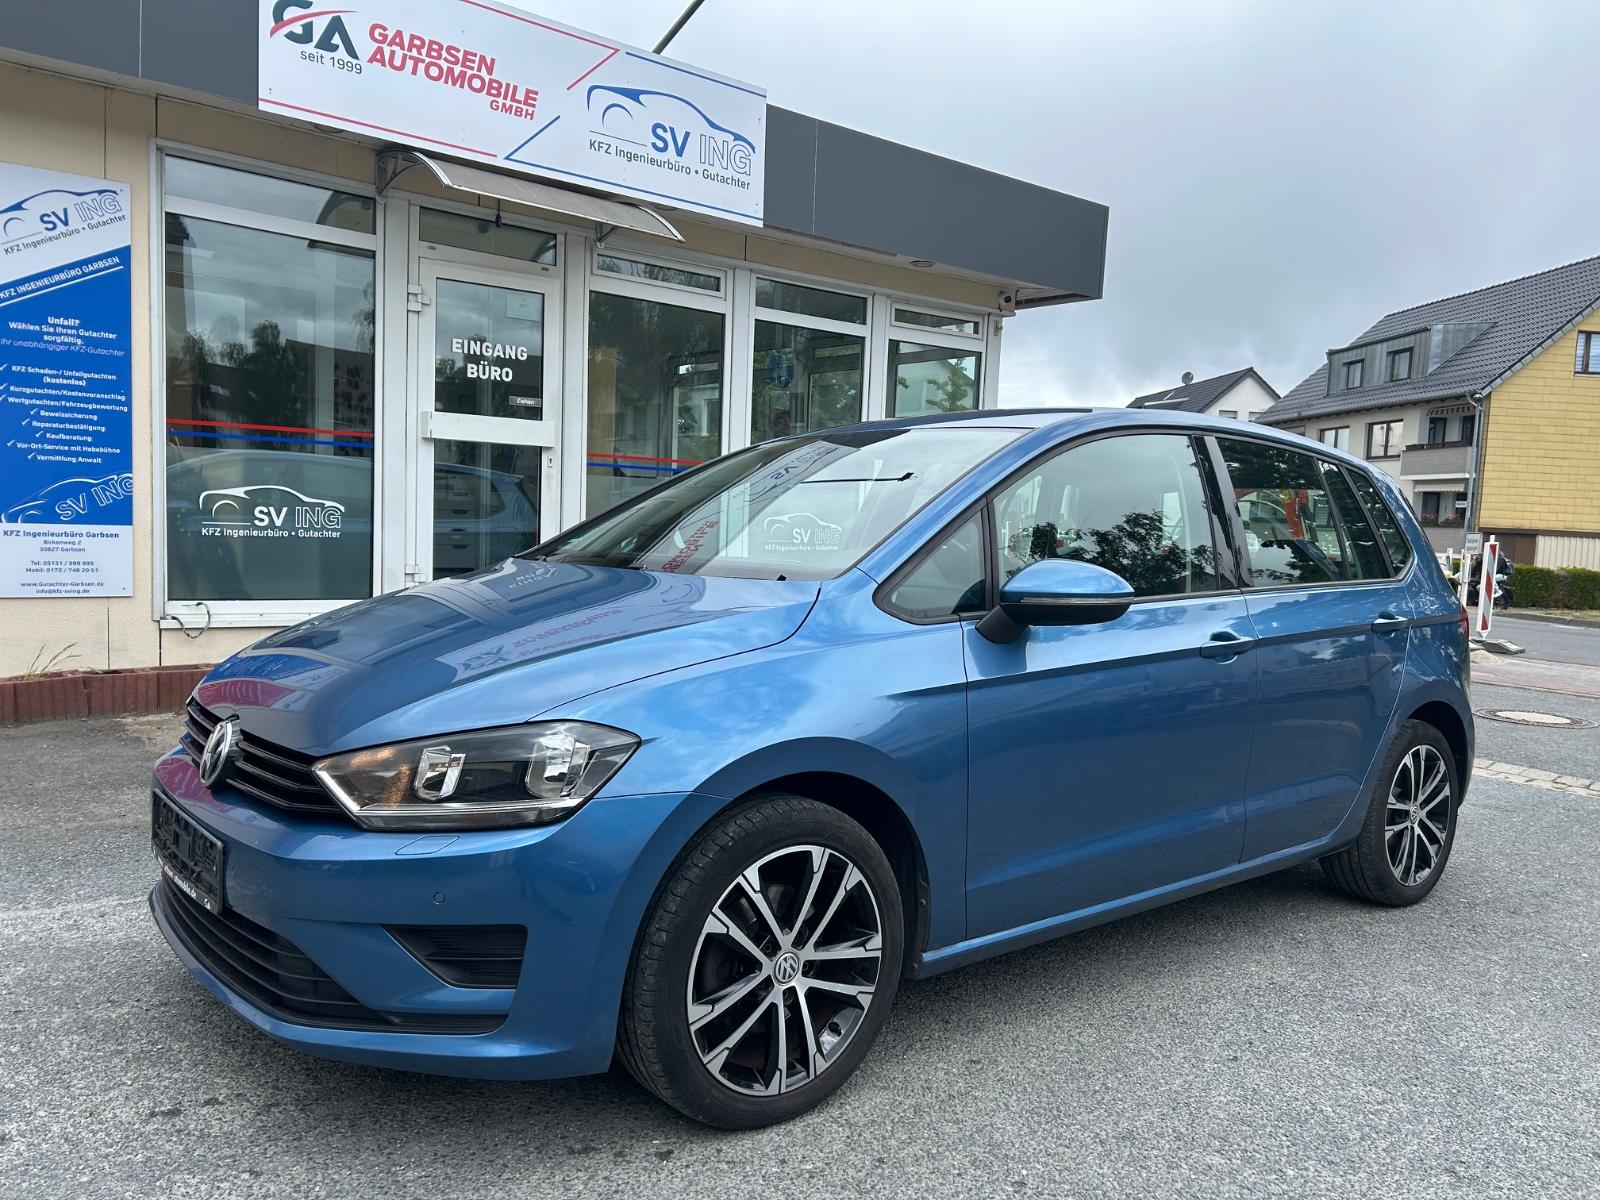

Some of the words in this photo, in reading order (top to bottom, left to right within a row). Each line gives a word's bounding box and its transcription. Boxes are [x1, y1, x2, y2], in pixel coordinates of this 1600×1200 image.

[368, 23, 496, 76] GARBSEN
[300, 50, 325, 66] seit
[330, 57, 363, 75] 1999
[366, 45, 539, 109] AUTOMOBILE
[489, 100, 535, 121] GMBH
[651, 122, 691, 157] SV
[700, 133, 751, 176] ING
[589, 138, 612, 155] KFZ
[615, 145, 691, 175] Ingenieurbüro
[702, 168, 751, 190] Gutachter
[39, 207, 70, 232] SV
[74, 193, 122, 222] ING
[4, 243, 22, 256] KFZ
[22, 226, 80, 251] Ingenieurbüro
[87, 213, 126, 231] Gutachter
[0, 287, 17, 299] KFZ
[17, 267, 82, 295] INGENIEURBÜRO
[82, 256, 120, 275] GARBSEN
[9, 321, 40, 331] Wählen
[41, 325, 54, 333] Sie
[56, 327, 77, 335] Ihren
[78, 329, 117, 339] Gutachter
[47, 316, 80, 327] Unfall?
[13, 339, 69, 351] unabhängiger
[70, 345, 125, 357] KFZ-Gutachter
[43, 334, 84, 345] sorgfältig.
[451, 338, 528, 361] EINGANG
[63, 370, 116, 380] Unfallgutachten
[466, 360, 513, 382] BÜRO
[40, 410, 98, 420] Beweissicherung
[32, 421, 105, 432] Reparaturbestätigung
[46, 433, 92, 442] Kaufberatung
[17, 442, 69, 451] Vor-Ort-Service
[82, 446, 120, 454] Hebebühne
[36, 454, 77, 463] Vermittlung
[55, 493, 87, 520] SV
[253, 506, 288, 527] SV
[295, 506, 341, 529] ING
[23, 530, 84, 538] Ingenieurbüro
[201, 527, 221, 536] KFZ
[223, 527, 289, 538] Ingenieurbüro
[298, 530, 341, 538] Gutachter
[792, 528, 811, 543] SV
[815, 528, 840, 544] ING
